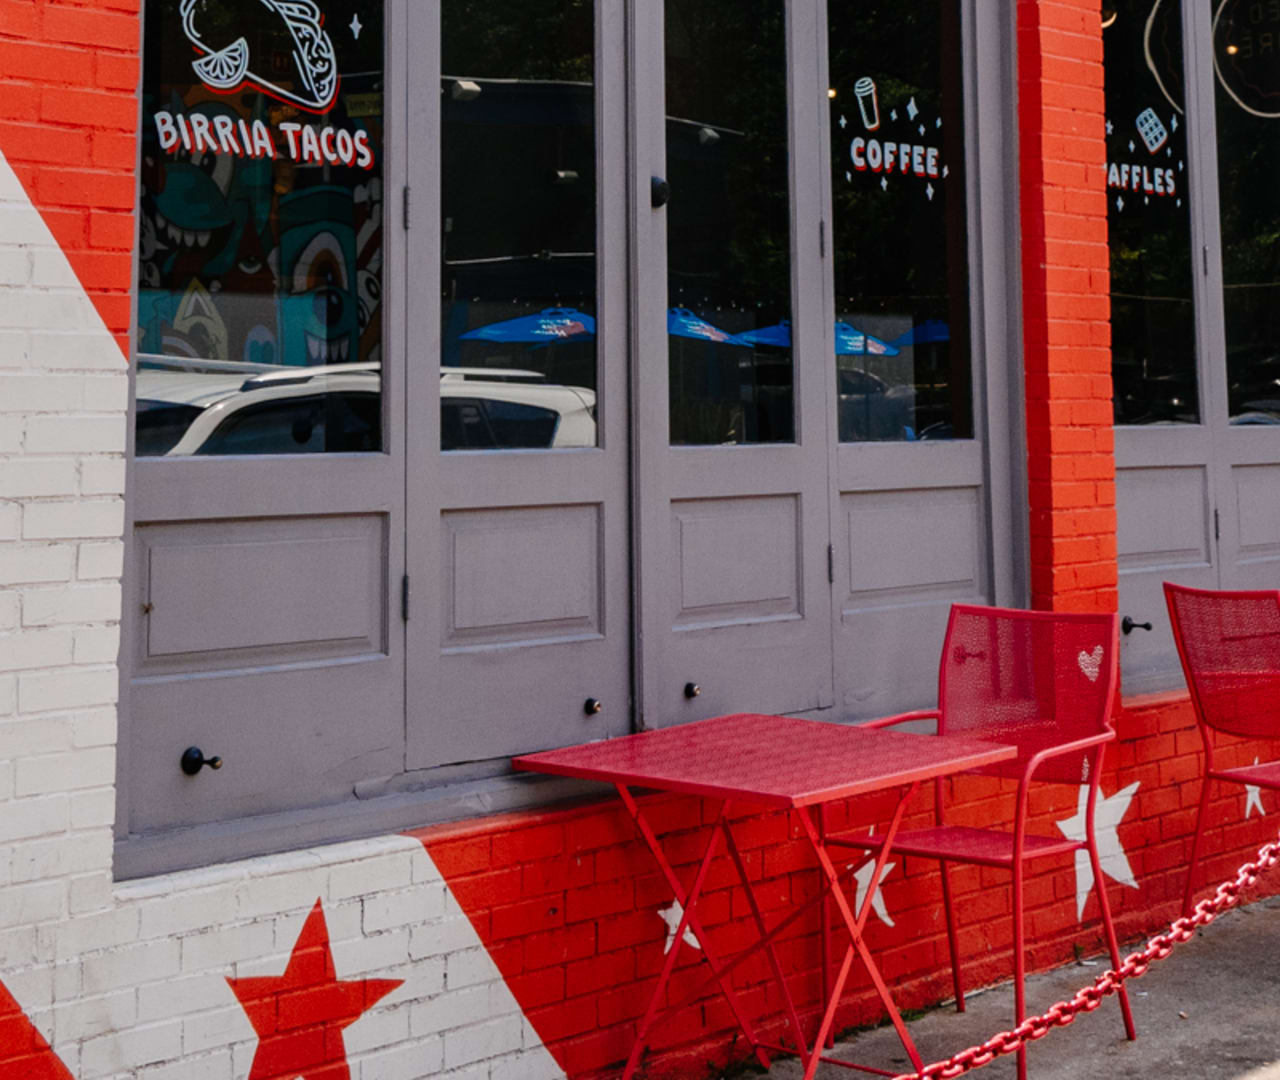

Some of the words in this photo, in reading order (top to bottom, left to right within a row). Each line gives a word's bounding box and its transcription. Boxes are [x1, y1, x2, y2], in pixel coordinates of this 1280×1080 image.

[153, 111, 277, 160] BIRRIA
[279, 122, 374, 170] TACOS
[850, 136, 939, 179] COFFEE
[1104, 162, 1177, 196] AFFLES
